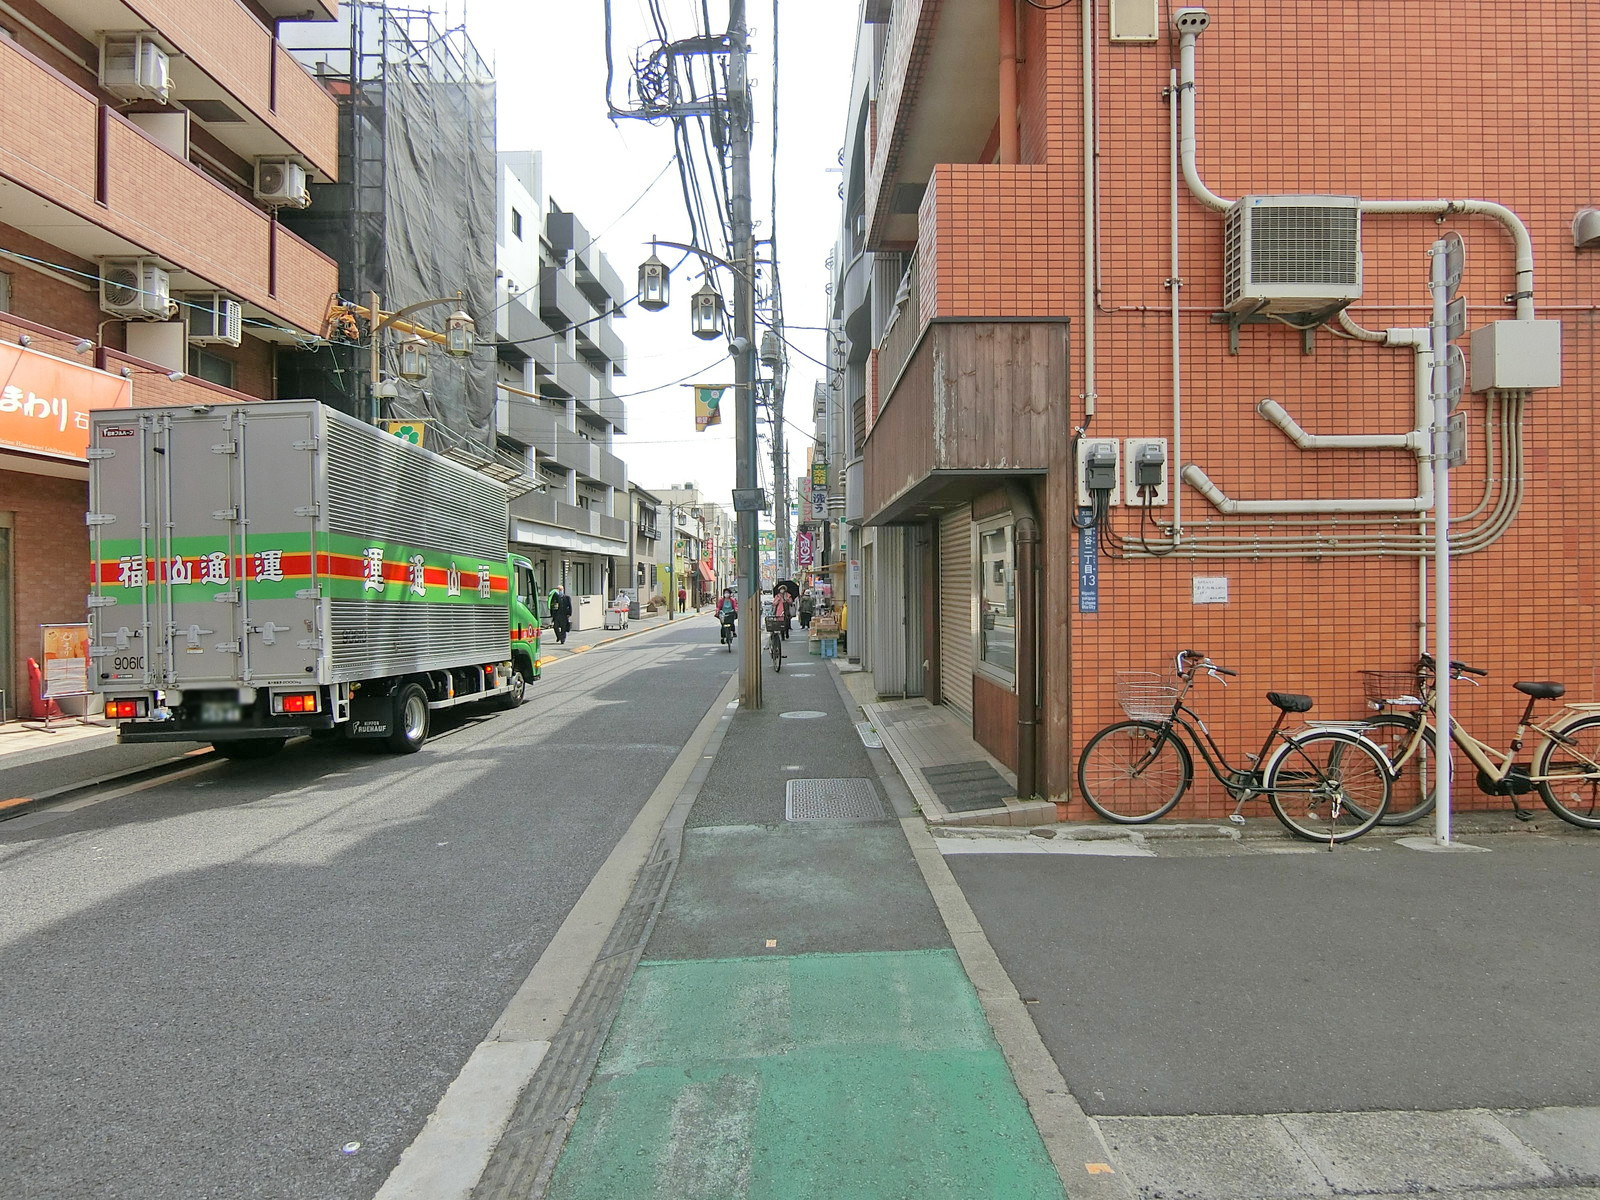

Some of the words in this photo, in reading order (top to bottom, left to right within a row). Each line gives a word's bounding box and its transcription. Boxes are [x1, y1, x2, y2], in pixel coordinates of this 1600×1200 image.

[117, 549, 286, 589] 福山通運
[1081, 575, 1096, 586] 13
